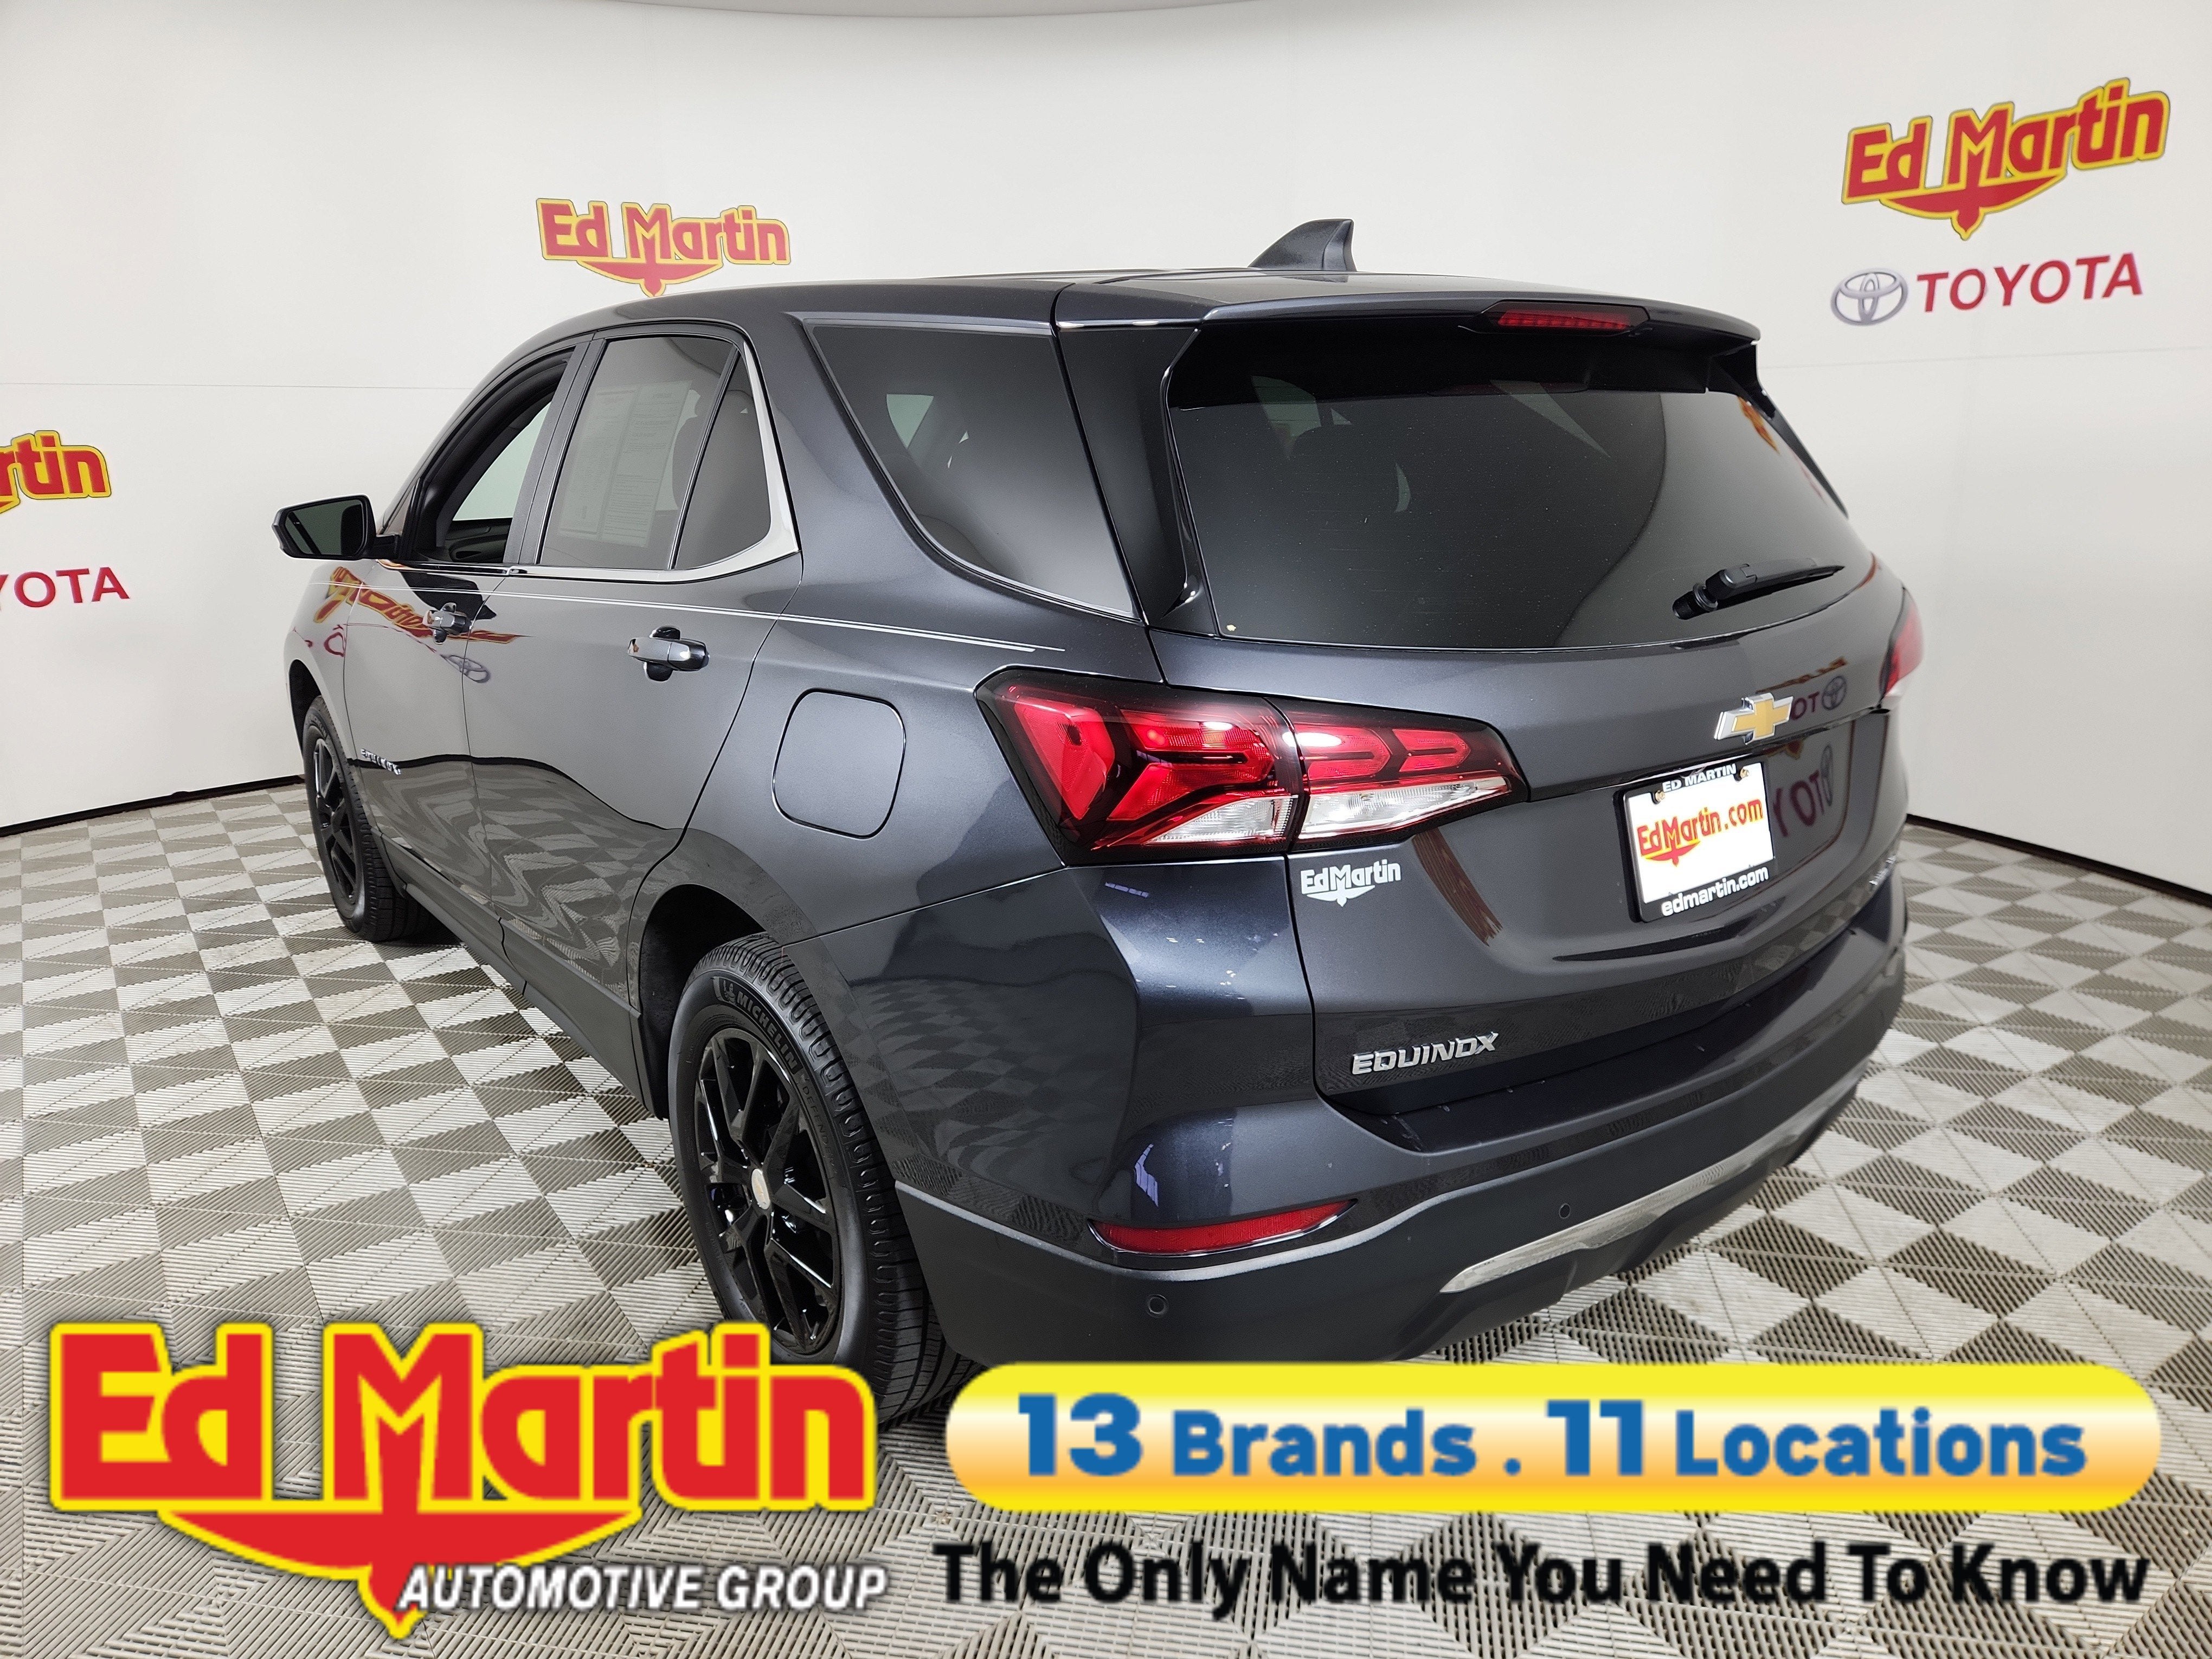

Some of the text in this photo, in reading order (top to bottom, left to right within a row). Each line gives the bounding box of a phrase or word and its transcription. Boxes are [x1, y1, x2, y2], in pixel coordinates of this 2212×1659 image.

[1844, 83, 2169, 201] Ed Martin
[539, 201, 788, 262] Ed Martin
[1917, 253, 2143, 312] TOYOTA
[0, 567, 130, 609] OTA
[1662, 763, 1737, 793] ED MARTIN
[1636, 798, 1764, 857] EdMartin.com
[1661, 866, 1769, 916] edmartin.com
[736, 991, 799, 1070] MICHELIN
[1352, 1031, 1499, 1075] EQUINOX
